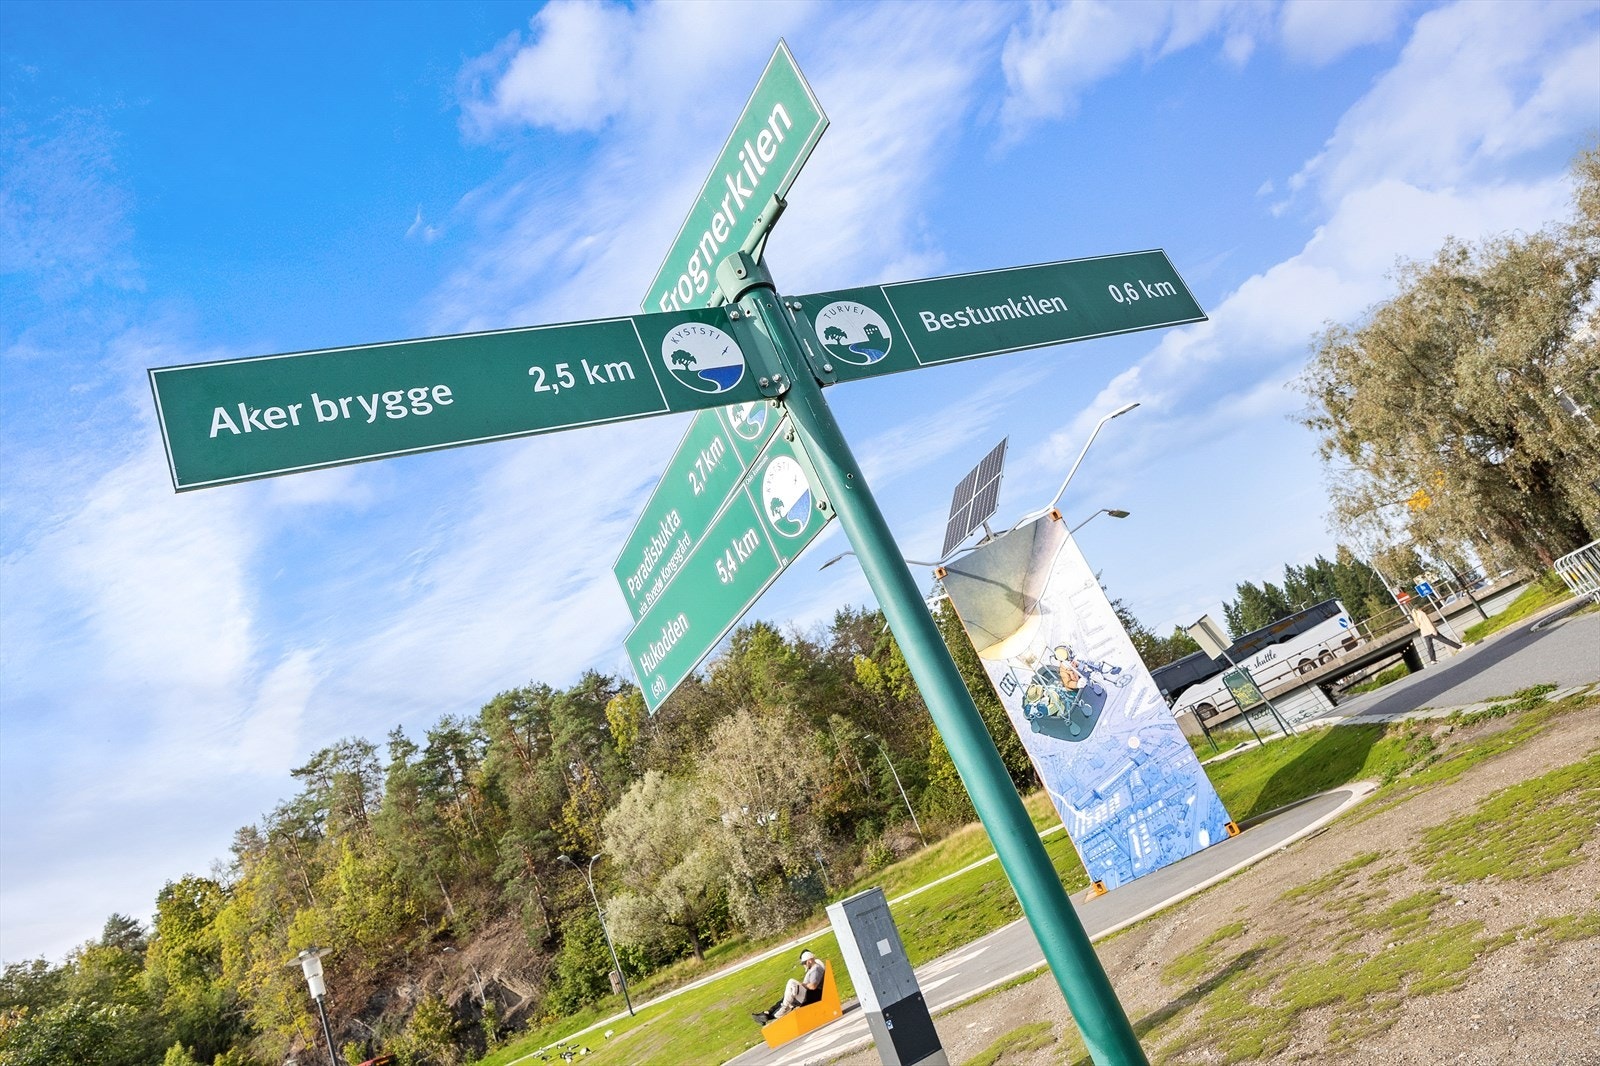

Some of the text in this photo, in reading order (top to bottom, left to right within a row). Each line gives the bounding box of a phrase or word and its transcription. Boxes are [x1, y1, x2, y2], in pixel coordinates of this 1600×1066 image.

[659, 102, 792, 313] Frognerkilen
[823, 305, 865, 320] TURVEI
[919, 294, 1068, 333] Bestumkilen
[1108, 279, 1177, 305] 0,6 km
[671, 327, 720, 344] KYSTSTI
[527, 355, 636, 395] 2,5 km
[208, 383, 454, 438] Aker brygge
[688, 435, 725, 495] 2,7 km
[627, 509, 681, 599] Paradisbukta
[661, 531, 691, 582] Kongsgård
[715, 528, 760, 585] 5,4 km
[639, 612, 689, 677] Hukodden
[1254, 650, 1277, 669] shuttle
[651, 675, 667, 700] (sti)
